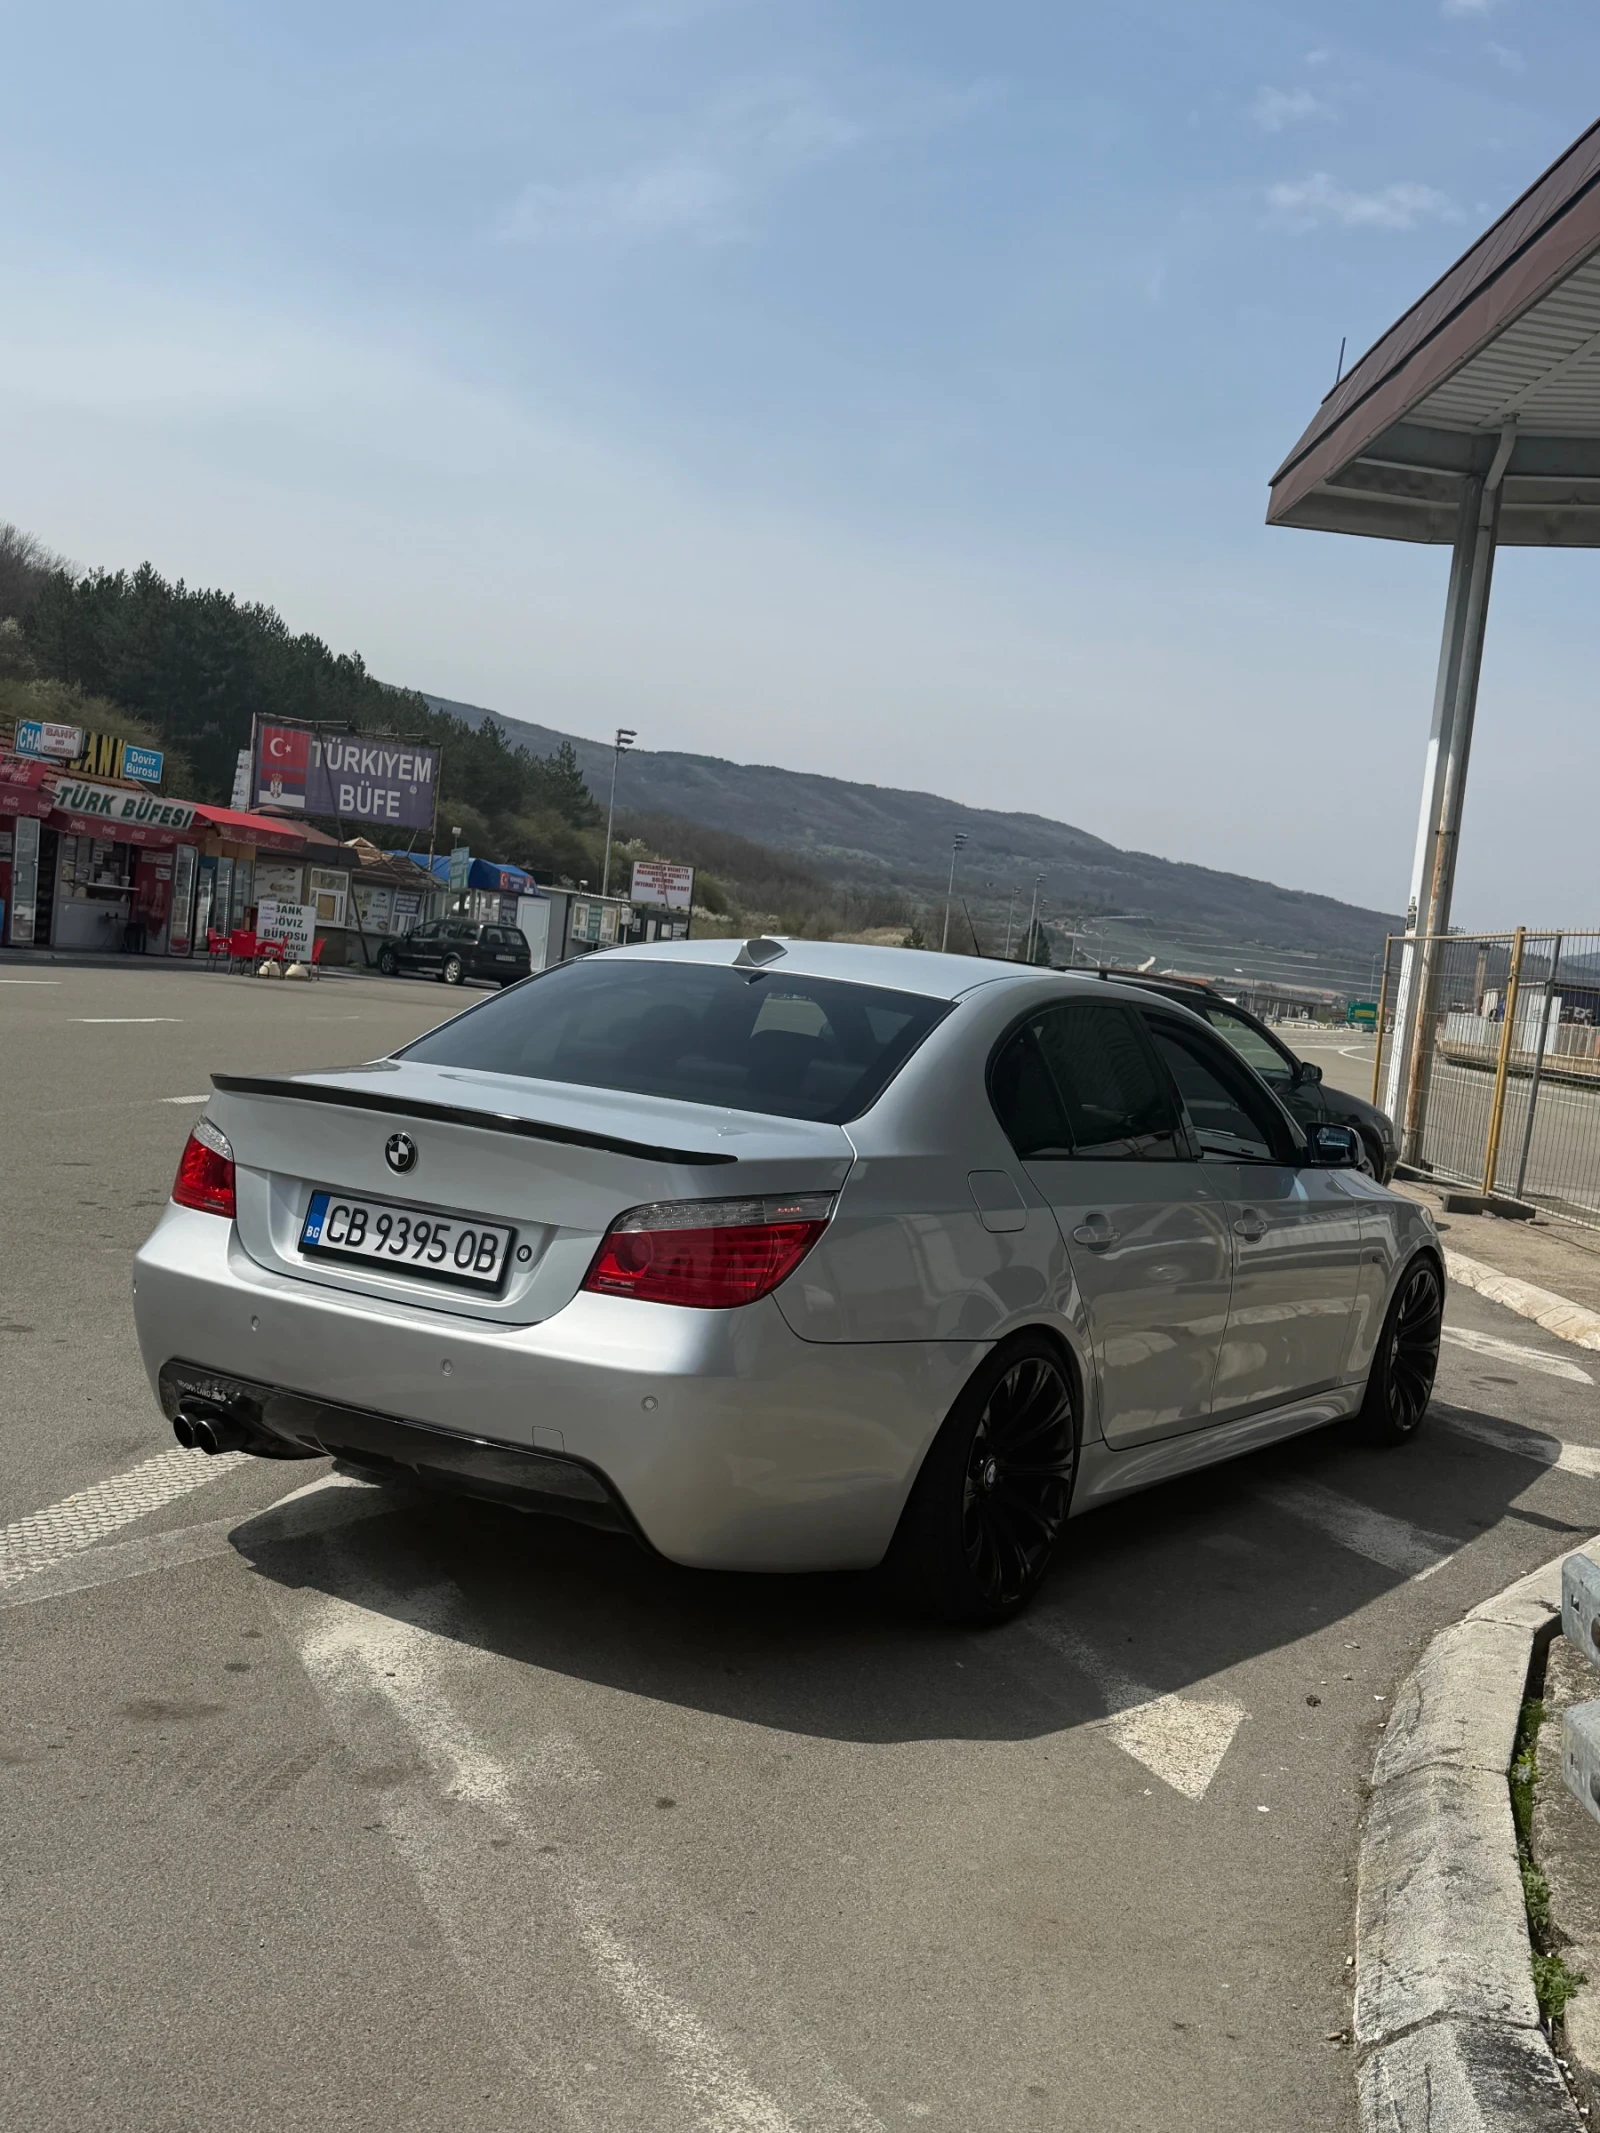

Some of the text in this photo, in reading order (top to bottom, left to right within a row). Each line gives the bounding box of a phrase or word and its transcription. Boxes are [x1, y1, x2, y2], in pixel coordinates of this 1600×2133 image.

[20, 726, 41, 752] CHA
[45, 727, 77, 740] BANK
[55, 738, 65, 746] NO
[70, 731, 127, 779] ANK
[131, 750, 157, 766] Döviz
[312, 738, 432, 783] TÜRKIYEM
[126, 762, 159, 779] Bürosu
[59, 784, 193, 829] TÜRK BÜFESI
[339, 780, 401, 818] BÜFE
[263, 928, 308, 942] BÜROSU
[387, 1134, 412, 1149] BMW
[306, 1226, 321, 1239] BG
[326, 1205, 369, 1247] CB
[374, 1213, 451, 1263] 9395
